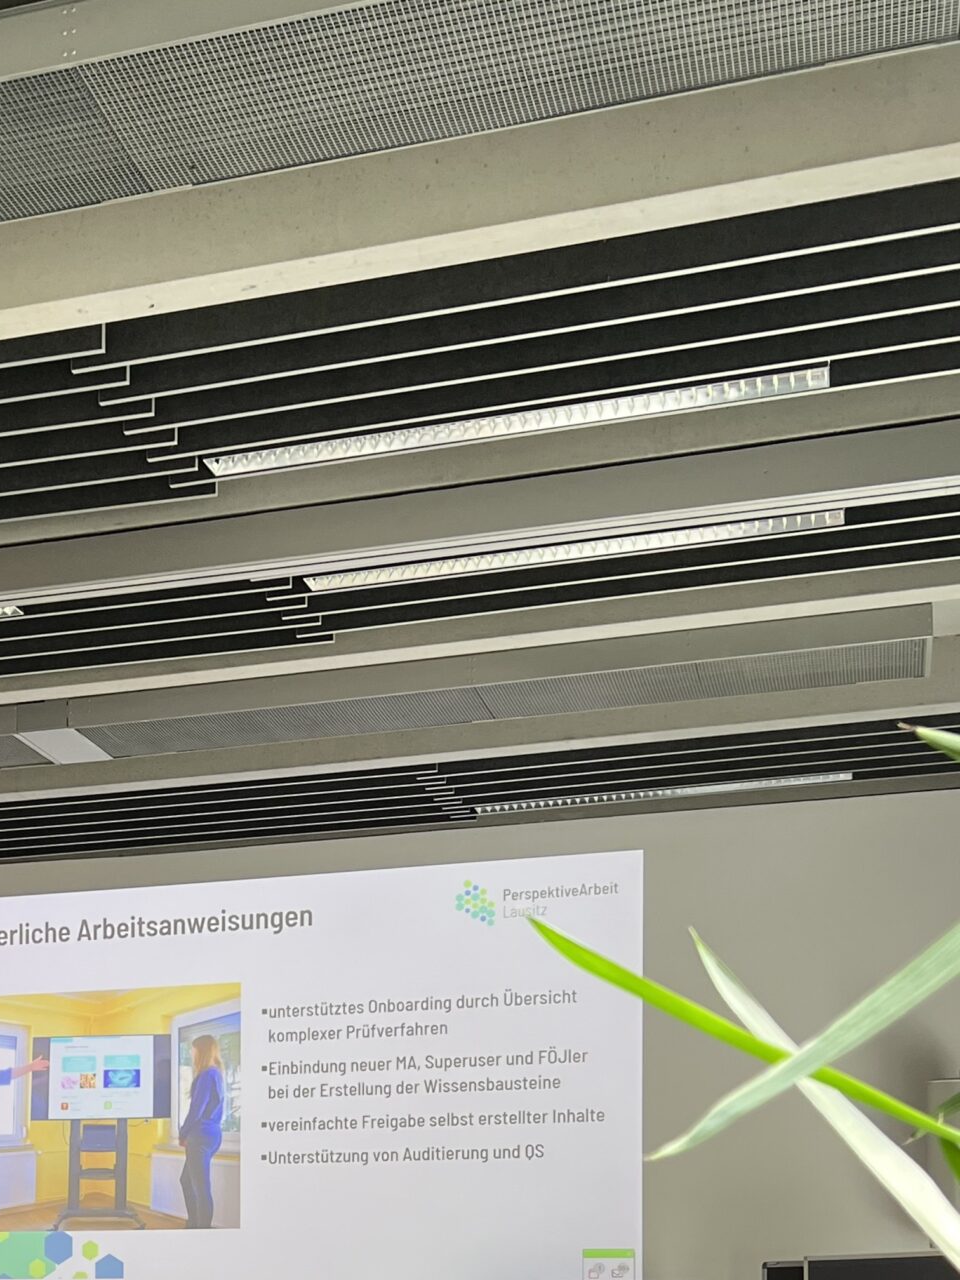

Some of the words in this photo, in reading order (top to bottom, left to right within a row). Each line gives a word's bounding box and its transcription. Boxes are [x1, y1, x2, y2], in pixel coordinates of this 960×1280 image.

[503, 882, 619, 902] PerspektiveArbeit
[503, 905, 548, 919] Lausitz
[77, 909, 313, 941] Arbeitsanweisungen
[269, 1002, 365, 1019] unterstütztes
[368, 997, 452, 1015] Onboarding
[456, 994, 499, 1010] durch
[503, 989, 578, 1007] Übersicht
[268, 1026, 342, 1044] komplexer
[346, 1021, 448, 1040] Prüfverfahren
[268, 1060, 347, 1077] Einbindung
[350, 1059, 392, 1073] neuer
[395, 1056, 421, 1072] MA,
[425, 1053, 501, 1072] Superuser
[506, 1050, 534, 1066] und
[538, 1046, 588, 1064] FÖJler
[268, 1084, 289, 1100] bei
[292, 1083, 315, 1099] der
[320, 1081, 392, 1099] Erstellung
[395, 1079, 420, 1095] der
[423, 1075, 561, 1094] Wissensbausteine
[268, 1116, 358, 1132] vereinfachte
[362, 1113, 425, 1132] Freigabe
[429, 1111, 474, 1127] selbst
[478, 1109, 548, 1126] erstellter
[552, 1107, 605, 1124] Inhalte
[268, 1148, 369, 1166] Unterstützung
[373, 1149, 399, 1162] von
[402, 1145, 489, 1164] Auditierung
[492, 1144, 520, 1160] und
[524, 1143, 545, 1161] QS
